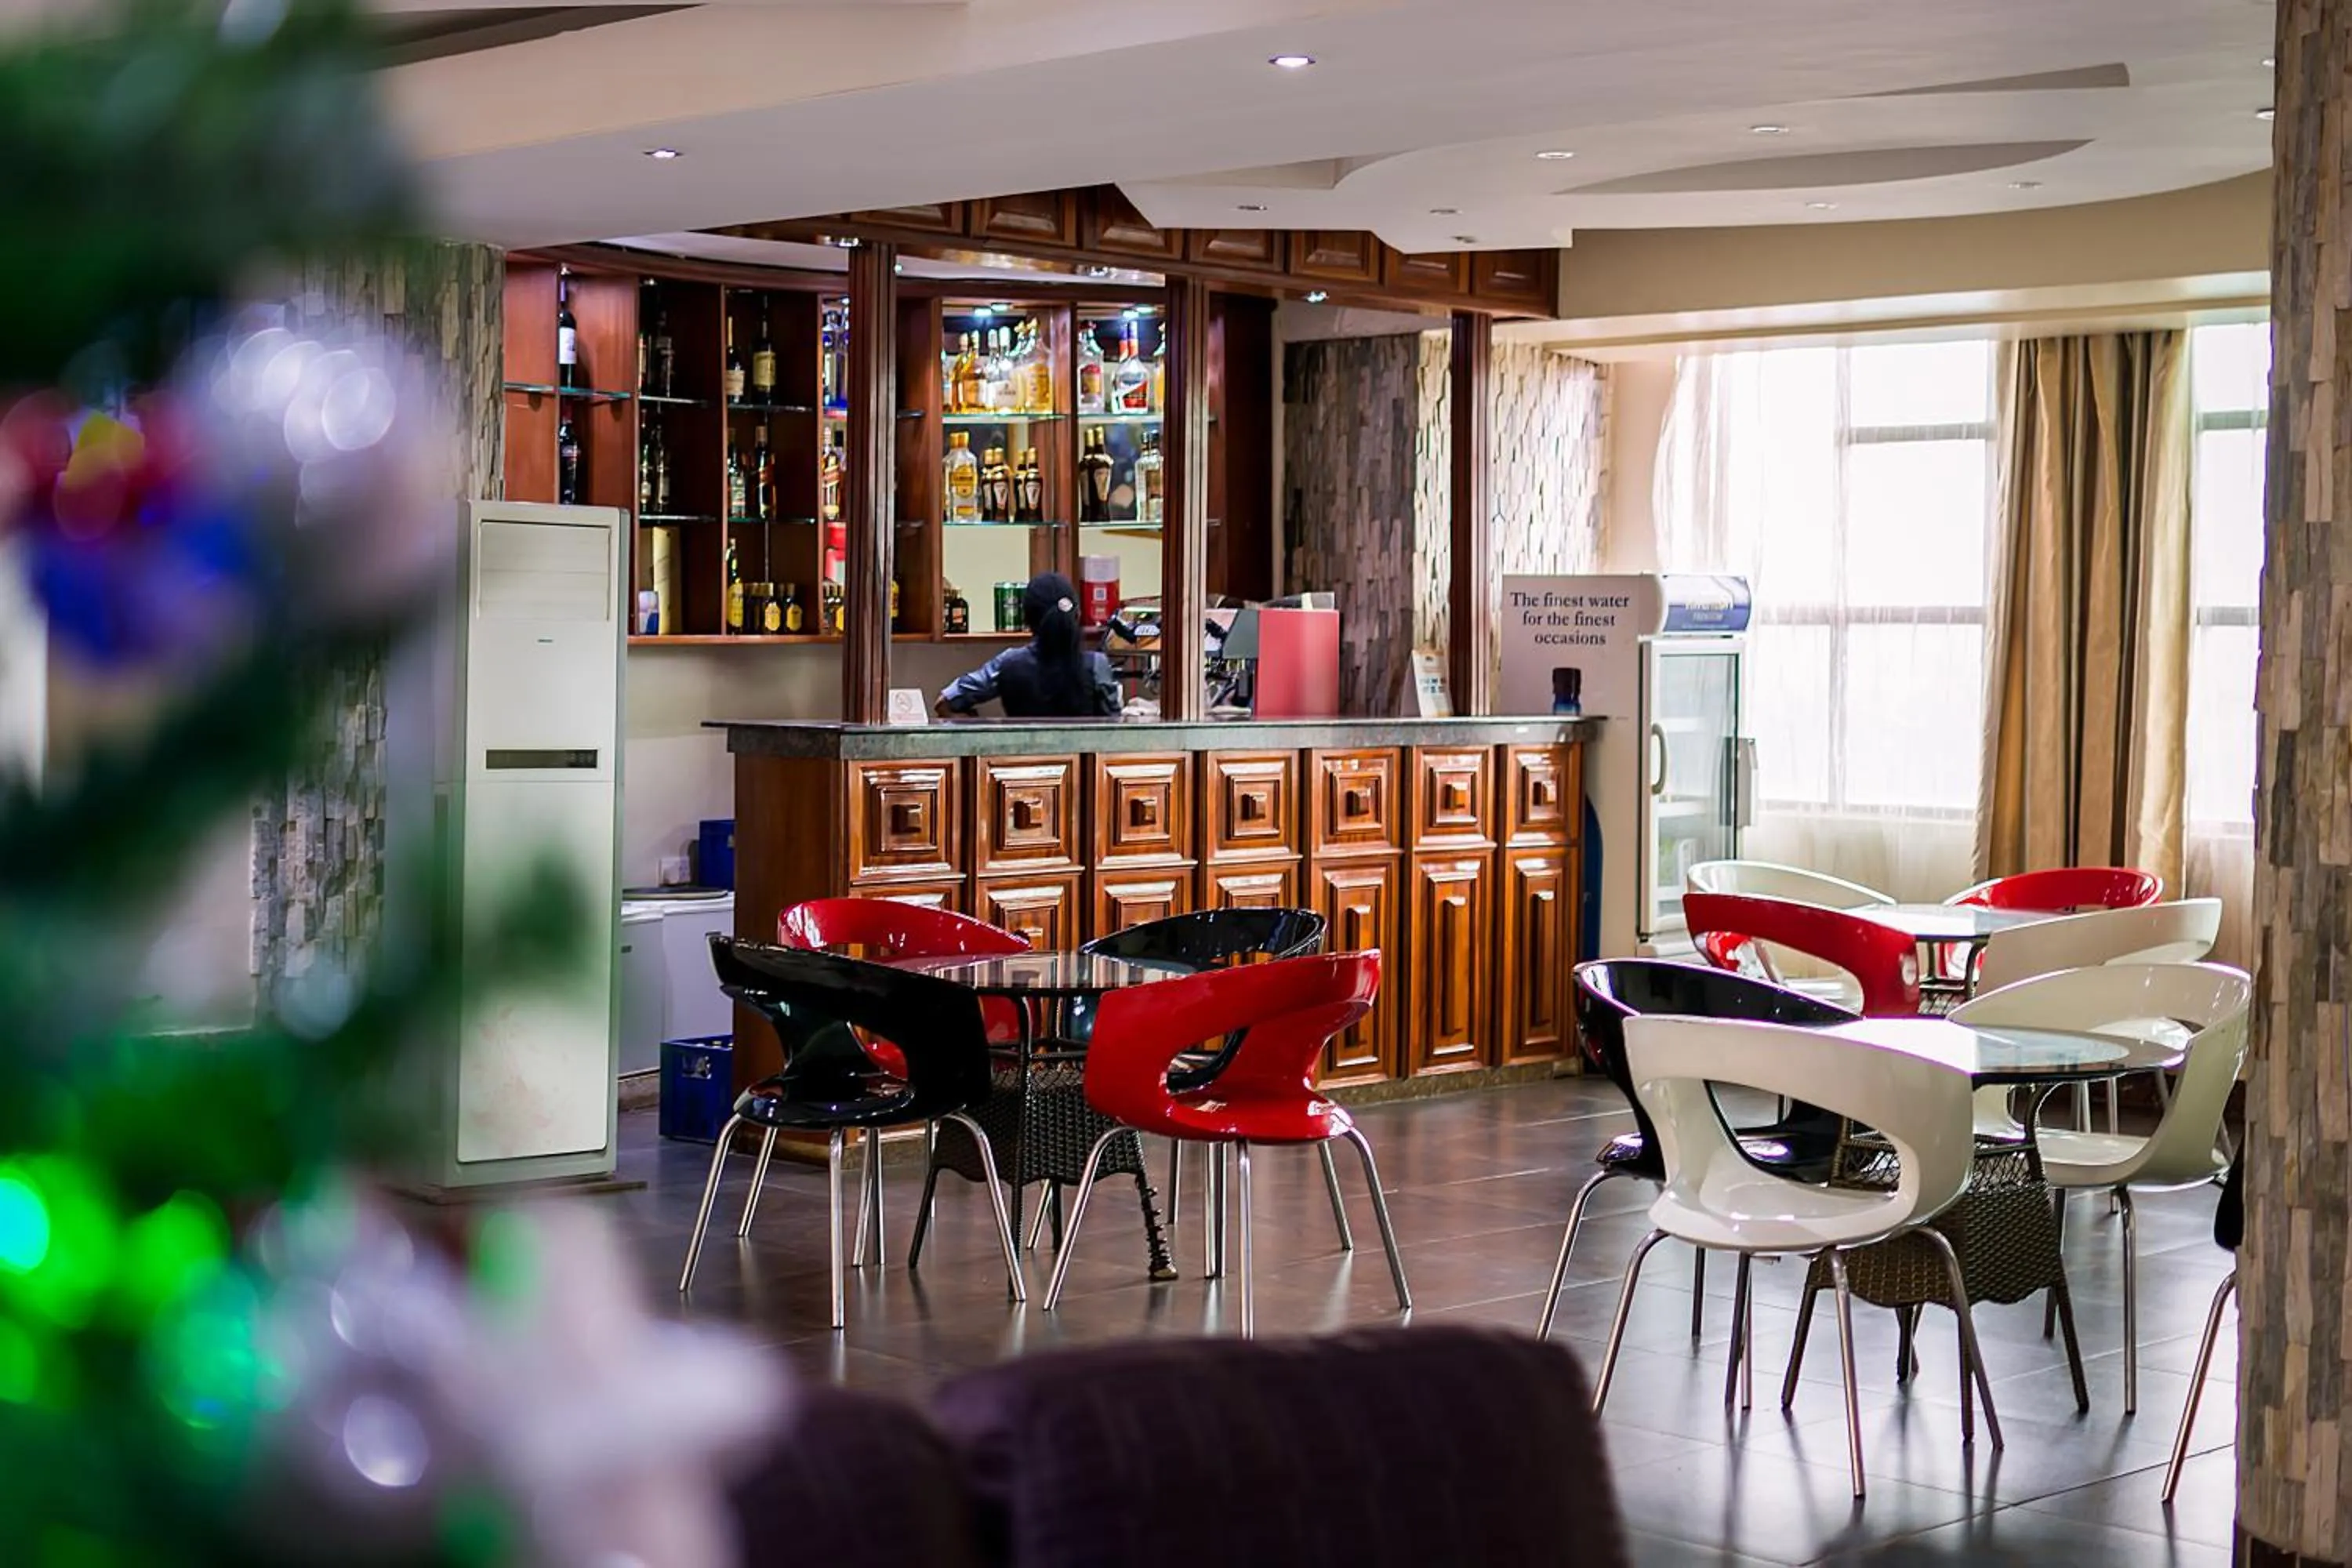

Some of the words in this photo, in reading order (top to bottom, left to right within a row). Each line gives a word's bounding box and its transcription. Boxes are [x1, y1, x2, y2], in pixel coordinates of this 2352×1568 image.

[1510, 592, 1539, 607] The
[1544, 592, 1584, 607] finest
[1588, 596, 1629, 608] water
[1523, 611, 1543, 626] for
[1547, 612, 1569, 626] the
[1574, 611, 1616, 626] finest
[1534, 630, 1606, 645] occasions
